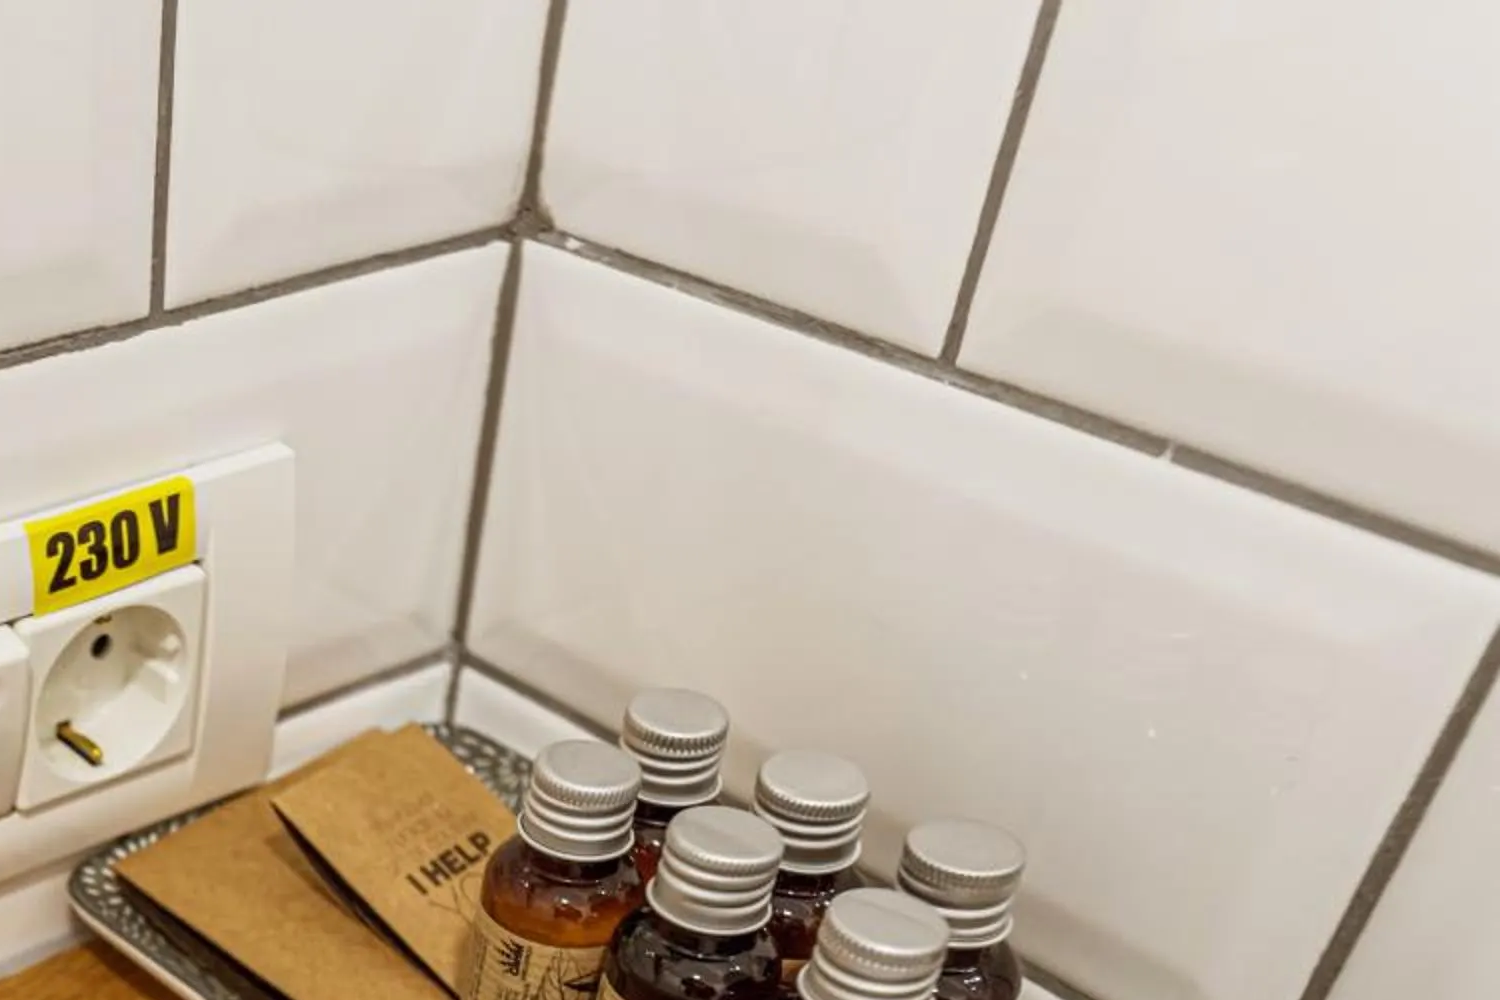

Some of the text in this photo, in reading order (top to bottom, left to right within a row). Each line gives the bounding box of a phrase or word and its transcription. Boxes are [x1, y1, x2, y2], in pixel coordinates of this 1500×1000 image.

[46, 493, 181, 594] 230 V
[405, 830, 492, 896] I HELP
